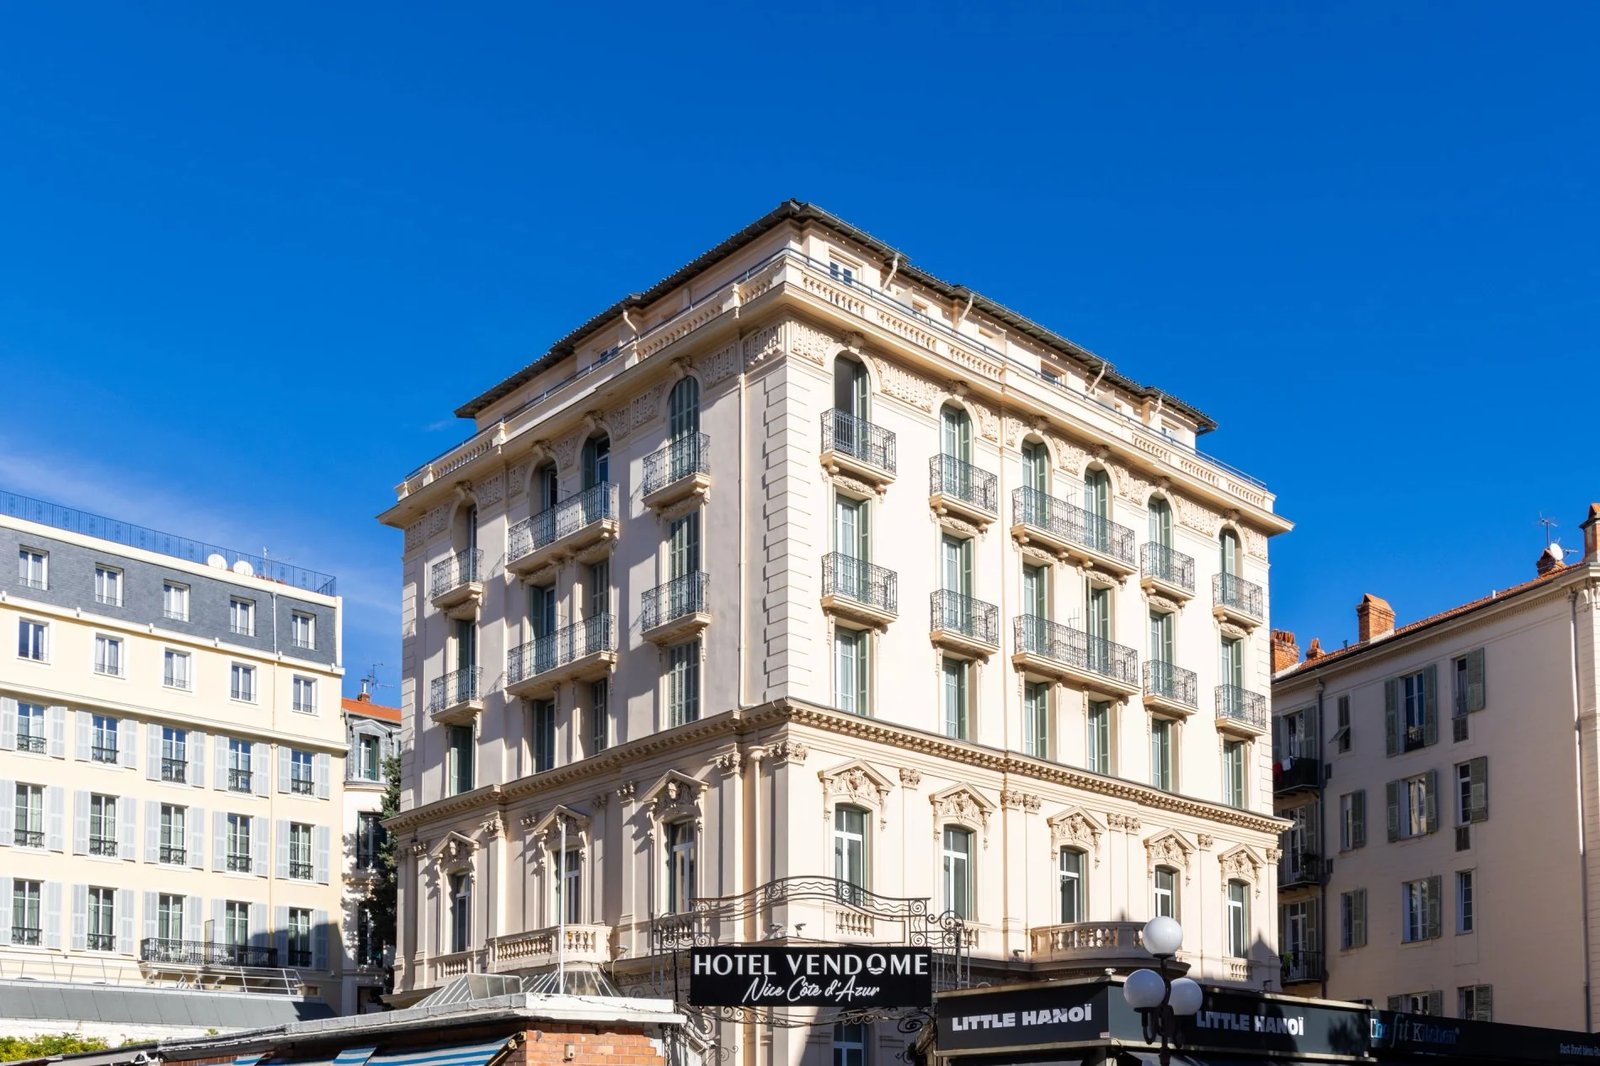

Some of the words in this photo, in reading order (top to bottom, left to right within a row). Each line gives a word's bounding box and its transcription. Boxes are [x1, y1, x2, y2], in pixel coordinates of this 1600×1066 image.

[694, 954, 777, 975] HOTEL
[786, 953, 928, 975] VENDOME
[742, 975, 785, 1003] Nice
[787, 976, 822, 1002] Côte
[824, 975, 880, 1002] d'Azur
[952, 1013, 1016, 1031] LITTLE
[1022, 1003, 1092, 1026] HANOÏ
[1196, 1010, 1250, 1031] LITTLE
[1254, 1015, 1304, 1036] HANOÏ
